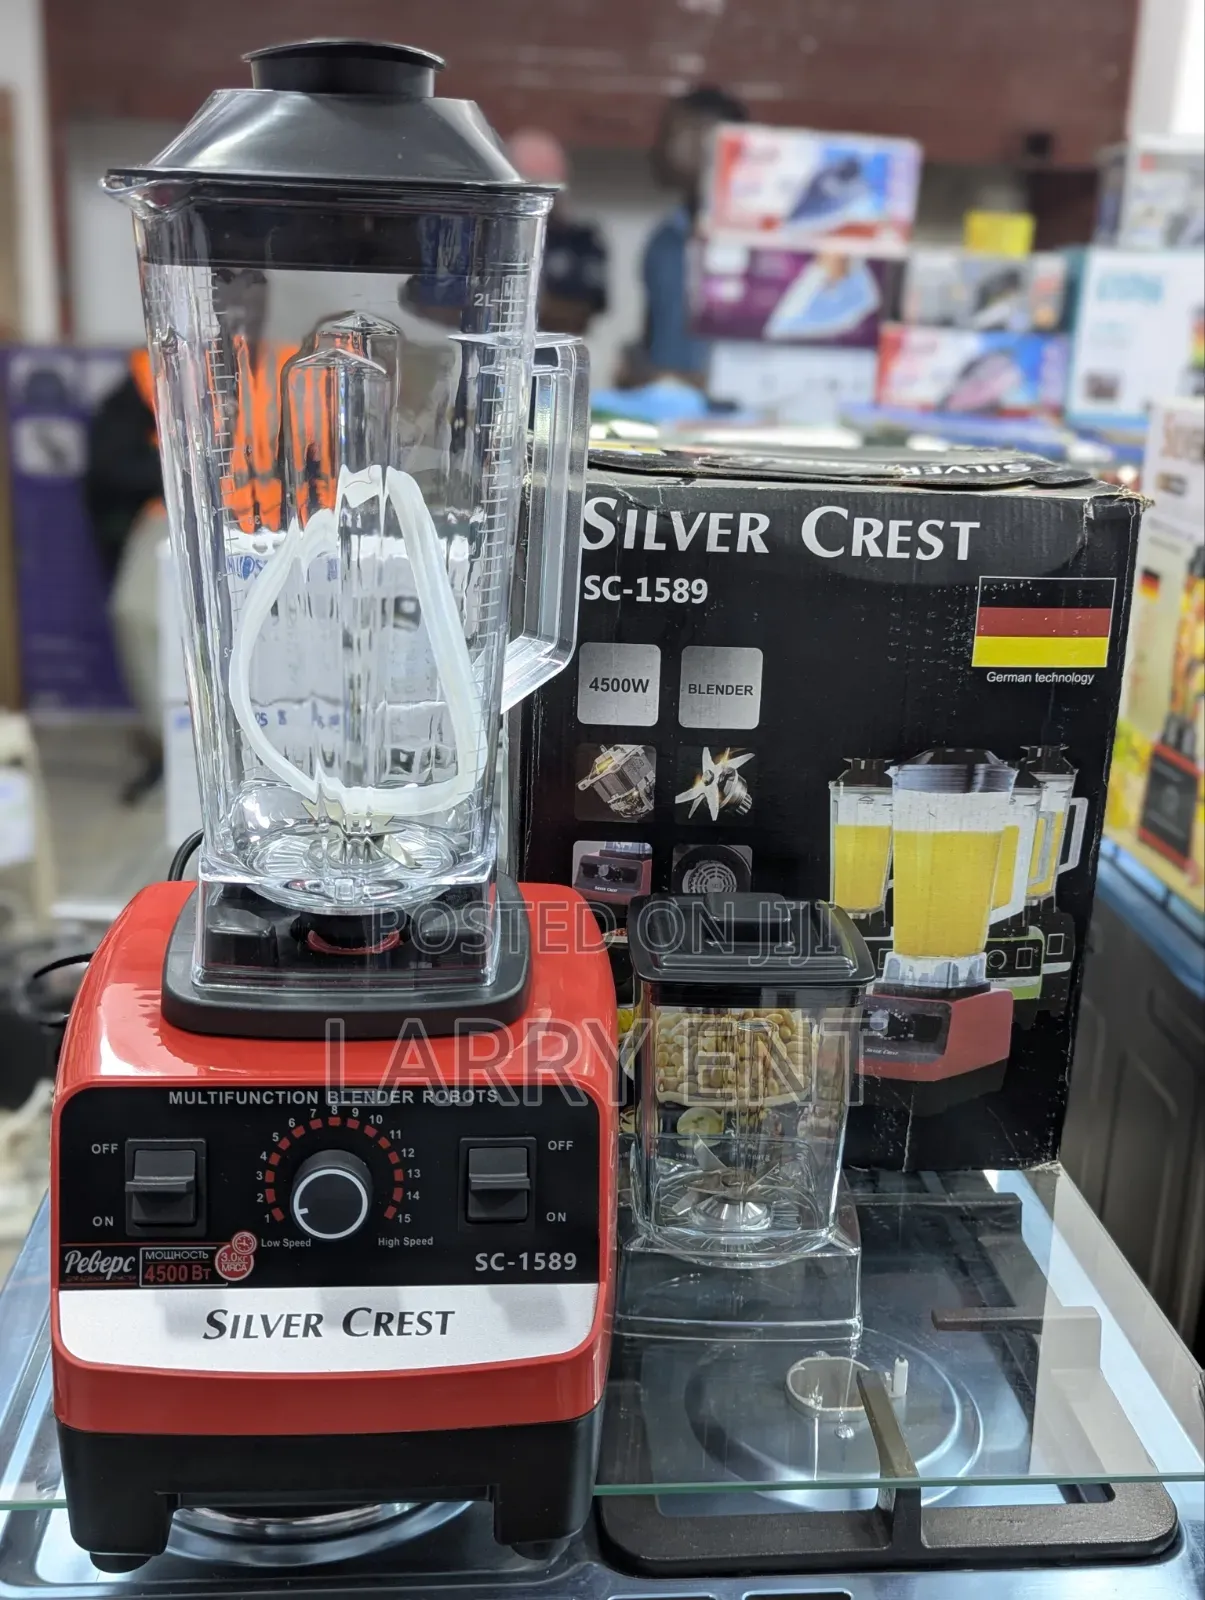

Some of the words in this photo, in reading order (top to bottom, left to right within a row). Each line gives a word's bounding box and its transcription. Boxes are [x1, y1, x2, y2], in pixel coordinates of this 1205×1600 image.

[474, 293, 494, 307] 2L
[581, 497, 770, 554] SILVER
[801, 505, 981, 561] CREST
[584, 575, 708, 604] SC-1589
[986, 671, 1032, 682] German
[1035, 672, 1095, 685] technology
[589, 677, 650, 694] 4500W
[688, 683, 754, 697] BLENDER
[168, 1090, 319, 1105] MULTIFUNCTION
[327, 1090, 414, 1104] BLENDER
[422, 1089, 499, 1103] ROBOTS
[310, 1108, 317, 1118] 7
[331, 1105, 338, 1115] 8
[352, 1107, 359, 1117] 9
[288, 1118, 296, 1128] 6
[369, 1114, 383, 1124] 10
[272, 1132, 279, 1142] 5
[389, 1129, 402, 1139] 11
[91, 1143, 119, 1154] OFF
[547, 1140, 574, 1151] OFF
[260, 1151, 267, 1161] 4
[401, 1148, 415, 1158] 12
[256, 1171, 263, 1180] 3
[407, 1168, 421, 1178] 13
[256, 1193, 264, 1203] 2
[406, 1191, 420, 1200] 14
[92, 1216, 114, 1227] ON
[264, 1214, 270, 1223] 1
[397, 1214, 411, 1223] 15
[546, 1212, 567, 1223] ON
[261, 1238, 280, 1247] Low
[282, 1238, 312, 1249] Speed
[378, 1237, 400, 1248] High
[403, 1236, 434, 1248] Speed
[145, 1250, 209, 1260] МОЩНОСТЬ
[64, 1250, 136, 1280] Реверс
[475, 1252, 577, 1271] SC-1589
[144, 1265, 189, 1283] 4500
[192, 1265, 212, 1282] Вт
[202, 1308, 324, 1340] SILVER
[342, 1306, 456, 1338] CREST
